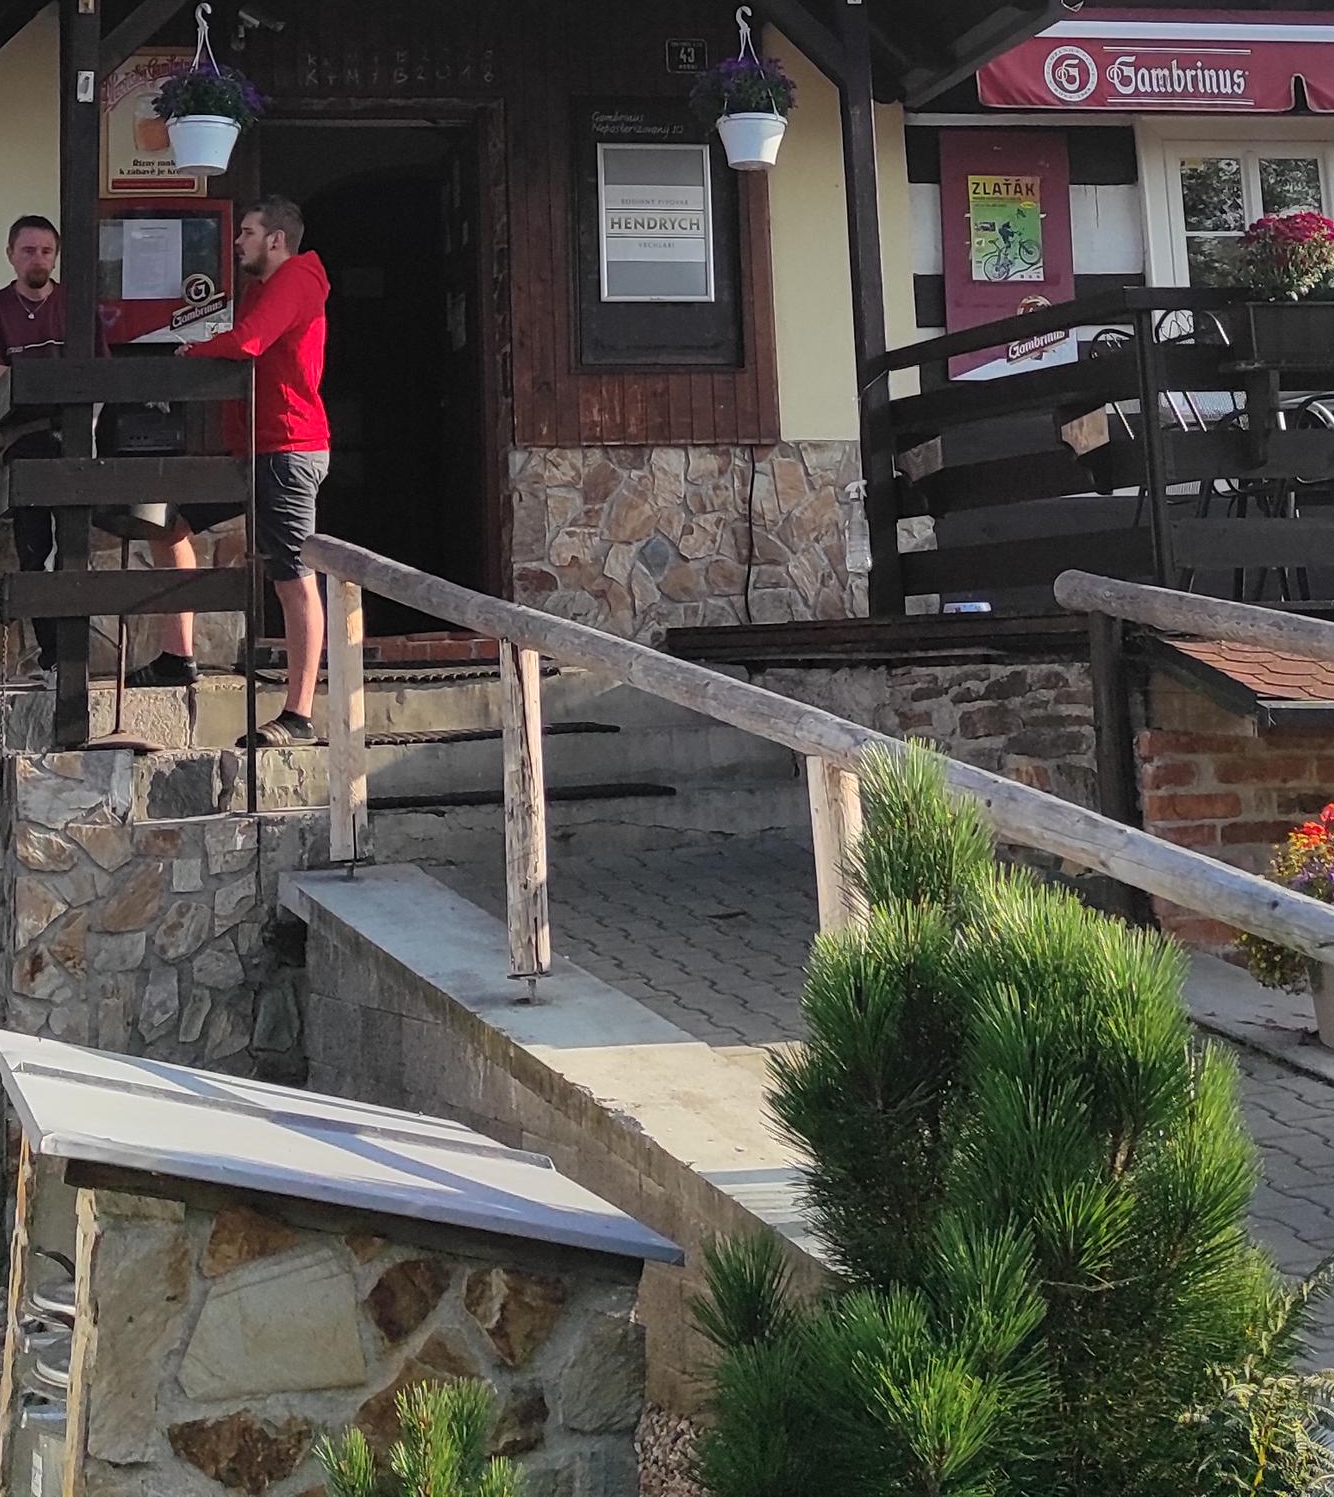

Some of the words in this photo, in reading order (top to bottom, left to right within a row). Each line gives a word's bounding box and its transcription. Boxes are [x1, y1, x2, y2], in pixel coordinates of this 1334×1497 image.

[679, 47, 695, 64] 43
[1106, 55, 1247, 95] Gambrinus
[971, 178, 1036, 196] ZLAŤÁK
[610, 217, 701, 231] HENDRYCH
[171, 300, 224, 328] Gambrinus
[1008, 330, 1066, 359] Gambrinus
